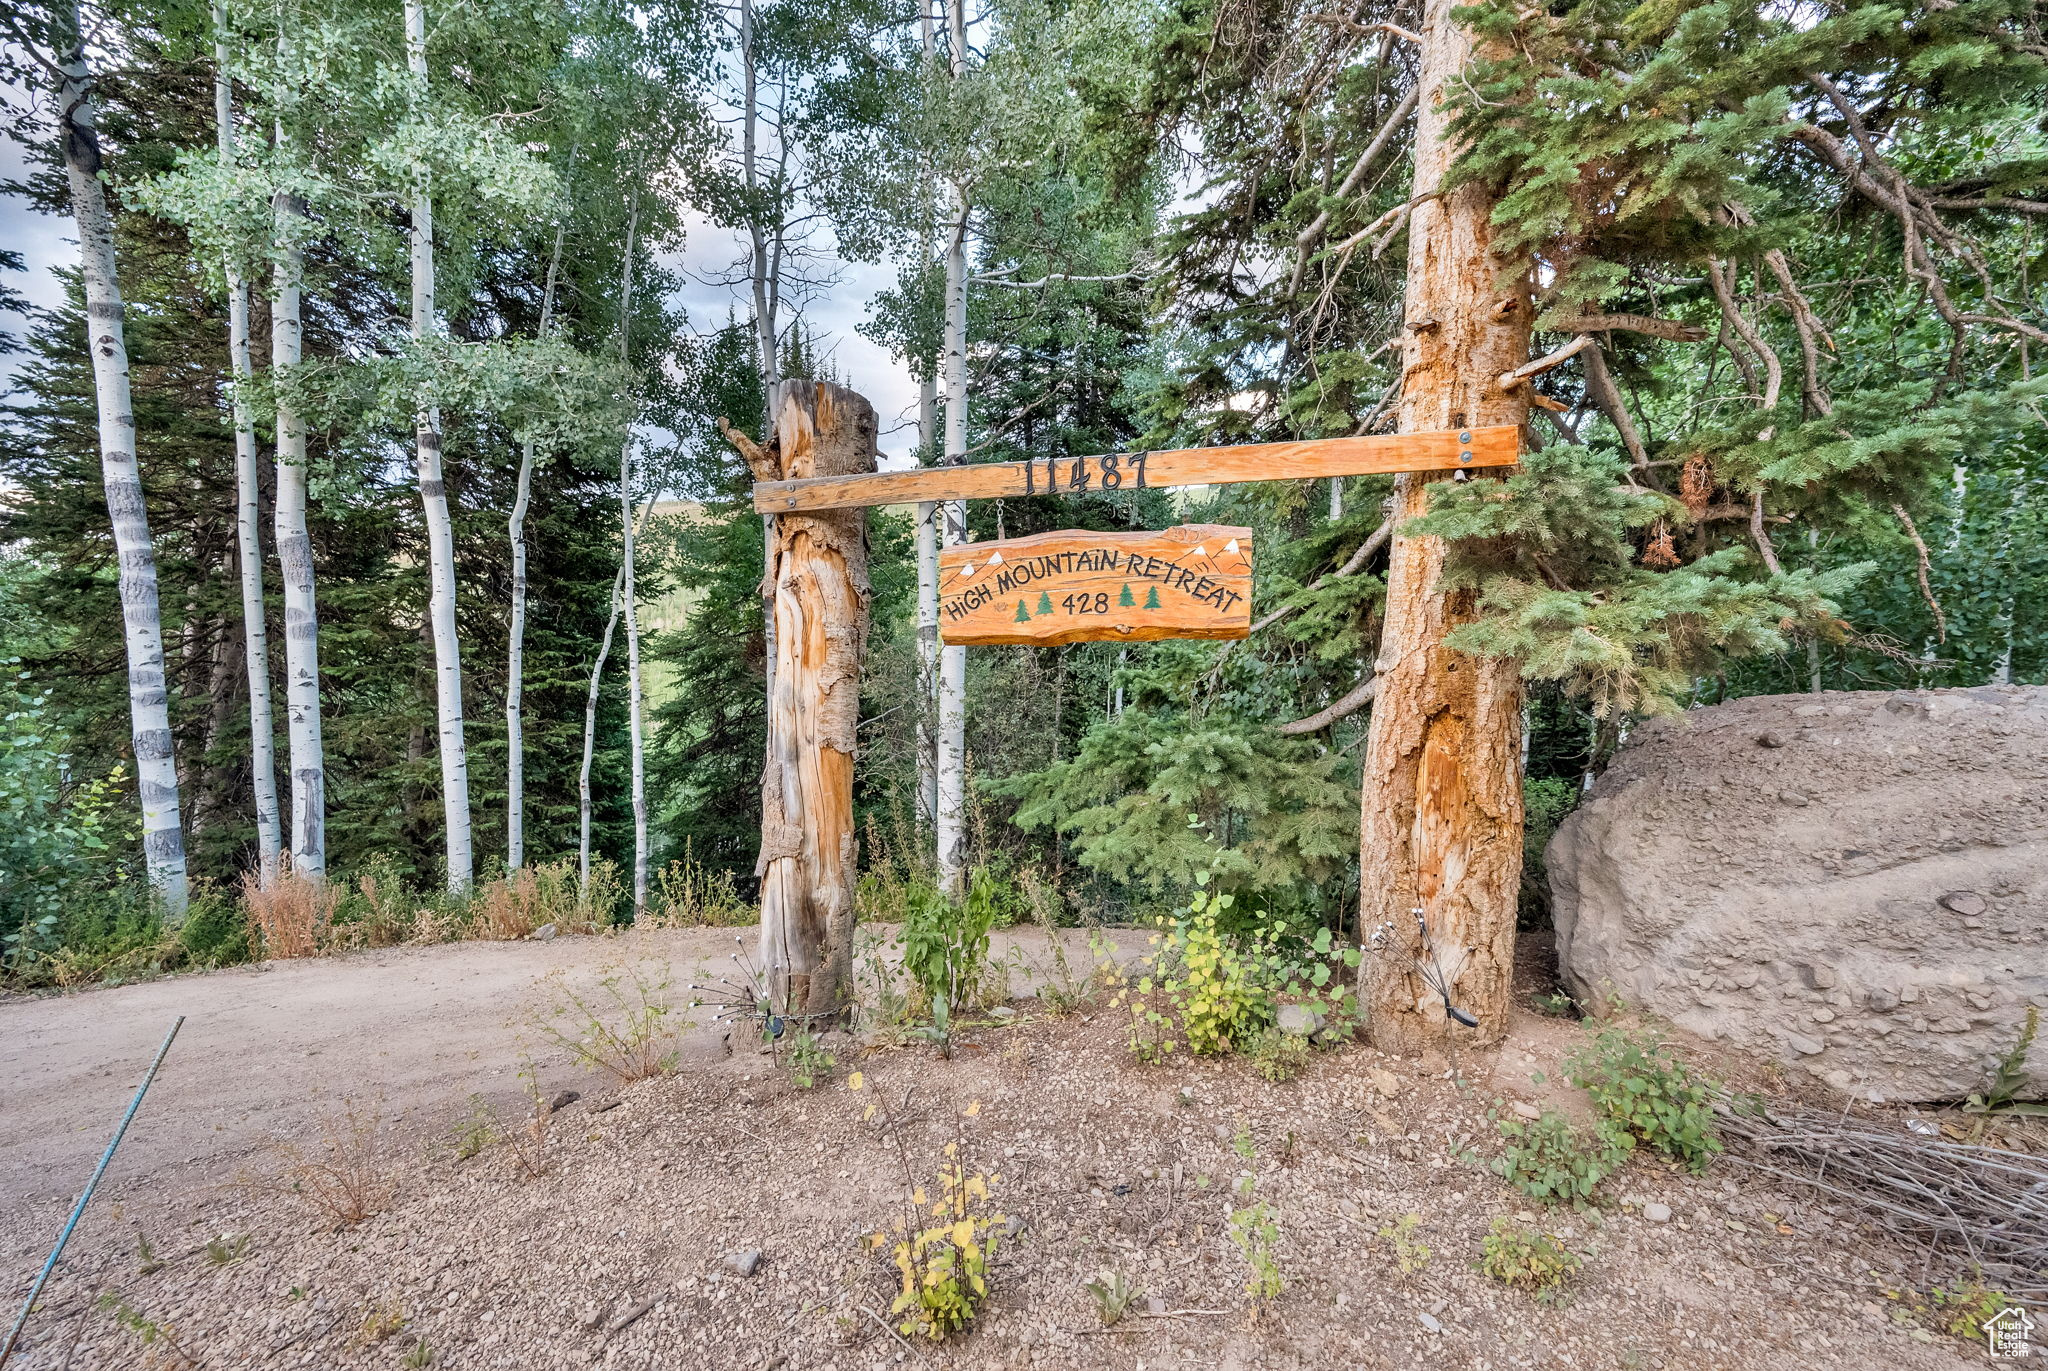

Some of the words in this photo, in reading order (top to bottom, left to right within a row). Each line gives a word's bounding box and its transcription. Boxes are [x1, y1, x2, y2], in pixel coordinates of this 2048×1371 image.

[1025, 451, 1148, 495] 11487
[1061, 592, 1109, 616] 428
[1125, 553, 1243, 613] RETREAT
